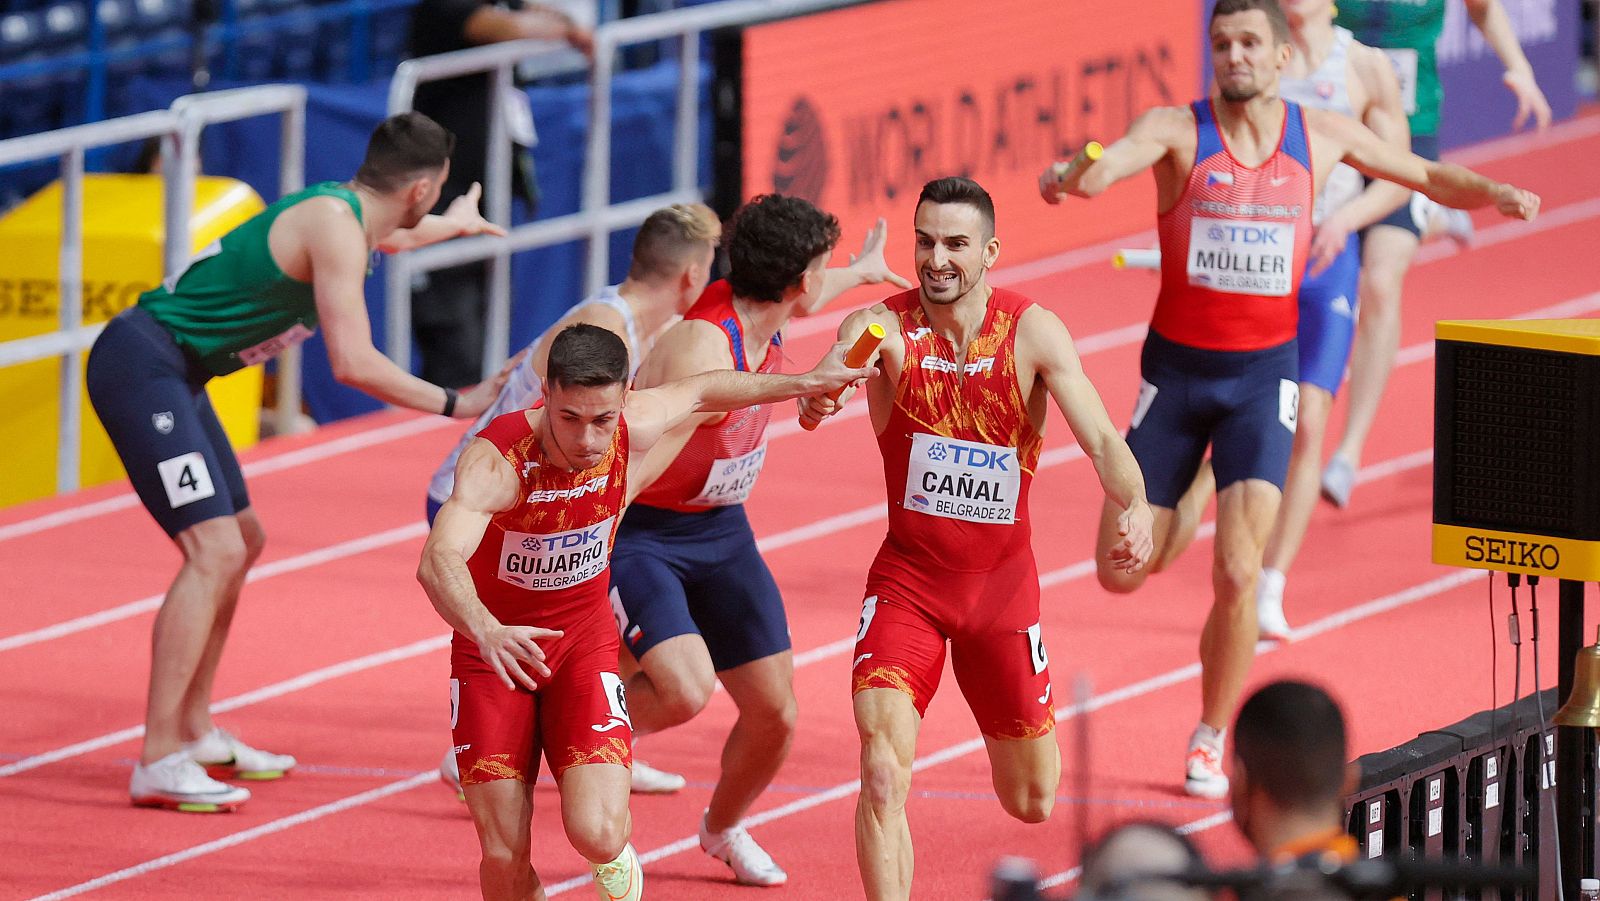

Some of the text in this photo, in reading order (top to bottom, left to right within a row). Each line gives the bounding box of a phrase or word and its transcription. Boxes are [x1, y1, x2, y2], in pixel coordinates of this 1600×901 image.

[1225, 225, 1278, 244] TDK
[1196, 247, 1285, 274] MÜLLER
[1218, 274, 1271, 289] BELGRADE
[948, 444, 1011, 472] TDK
[178, 464, 198, 491] 4
[527, 475, 609, 503] ESPAÑA
[922, 471, 1004, 502] CAÑAL
[935, 500, 1011, 521] BELGRADE 22
[542, 526, 602, 551] TDK
[506, 540, 603, 575] GUIJARRO
[1465, 535, 1560, 570] SEIKO
[532, 561, 604, 588] BELGRADE 22
